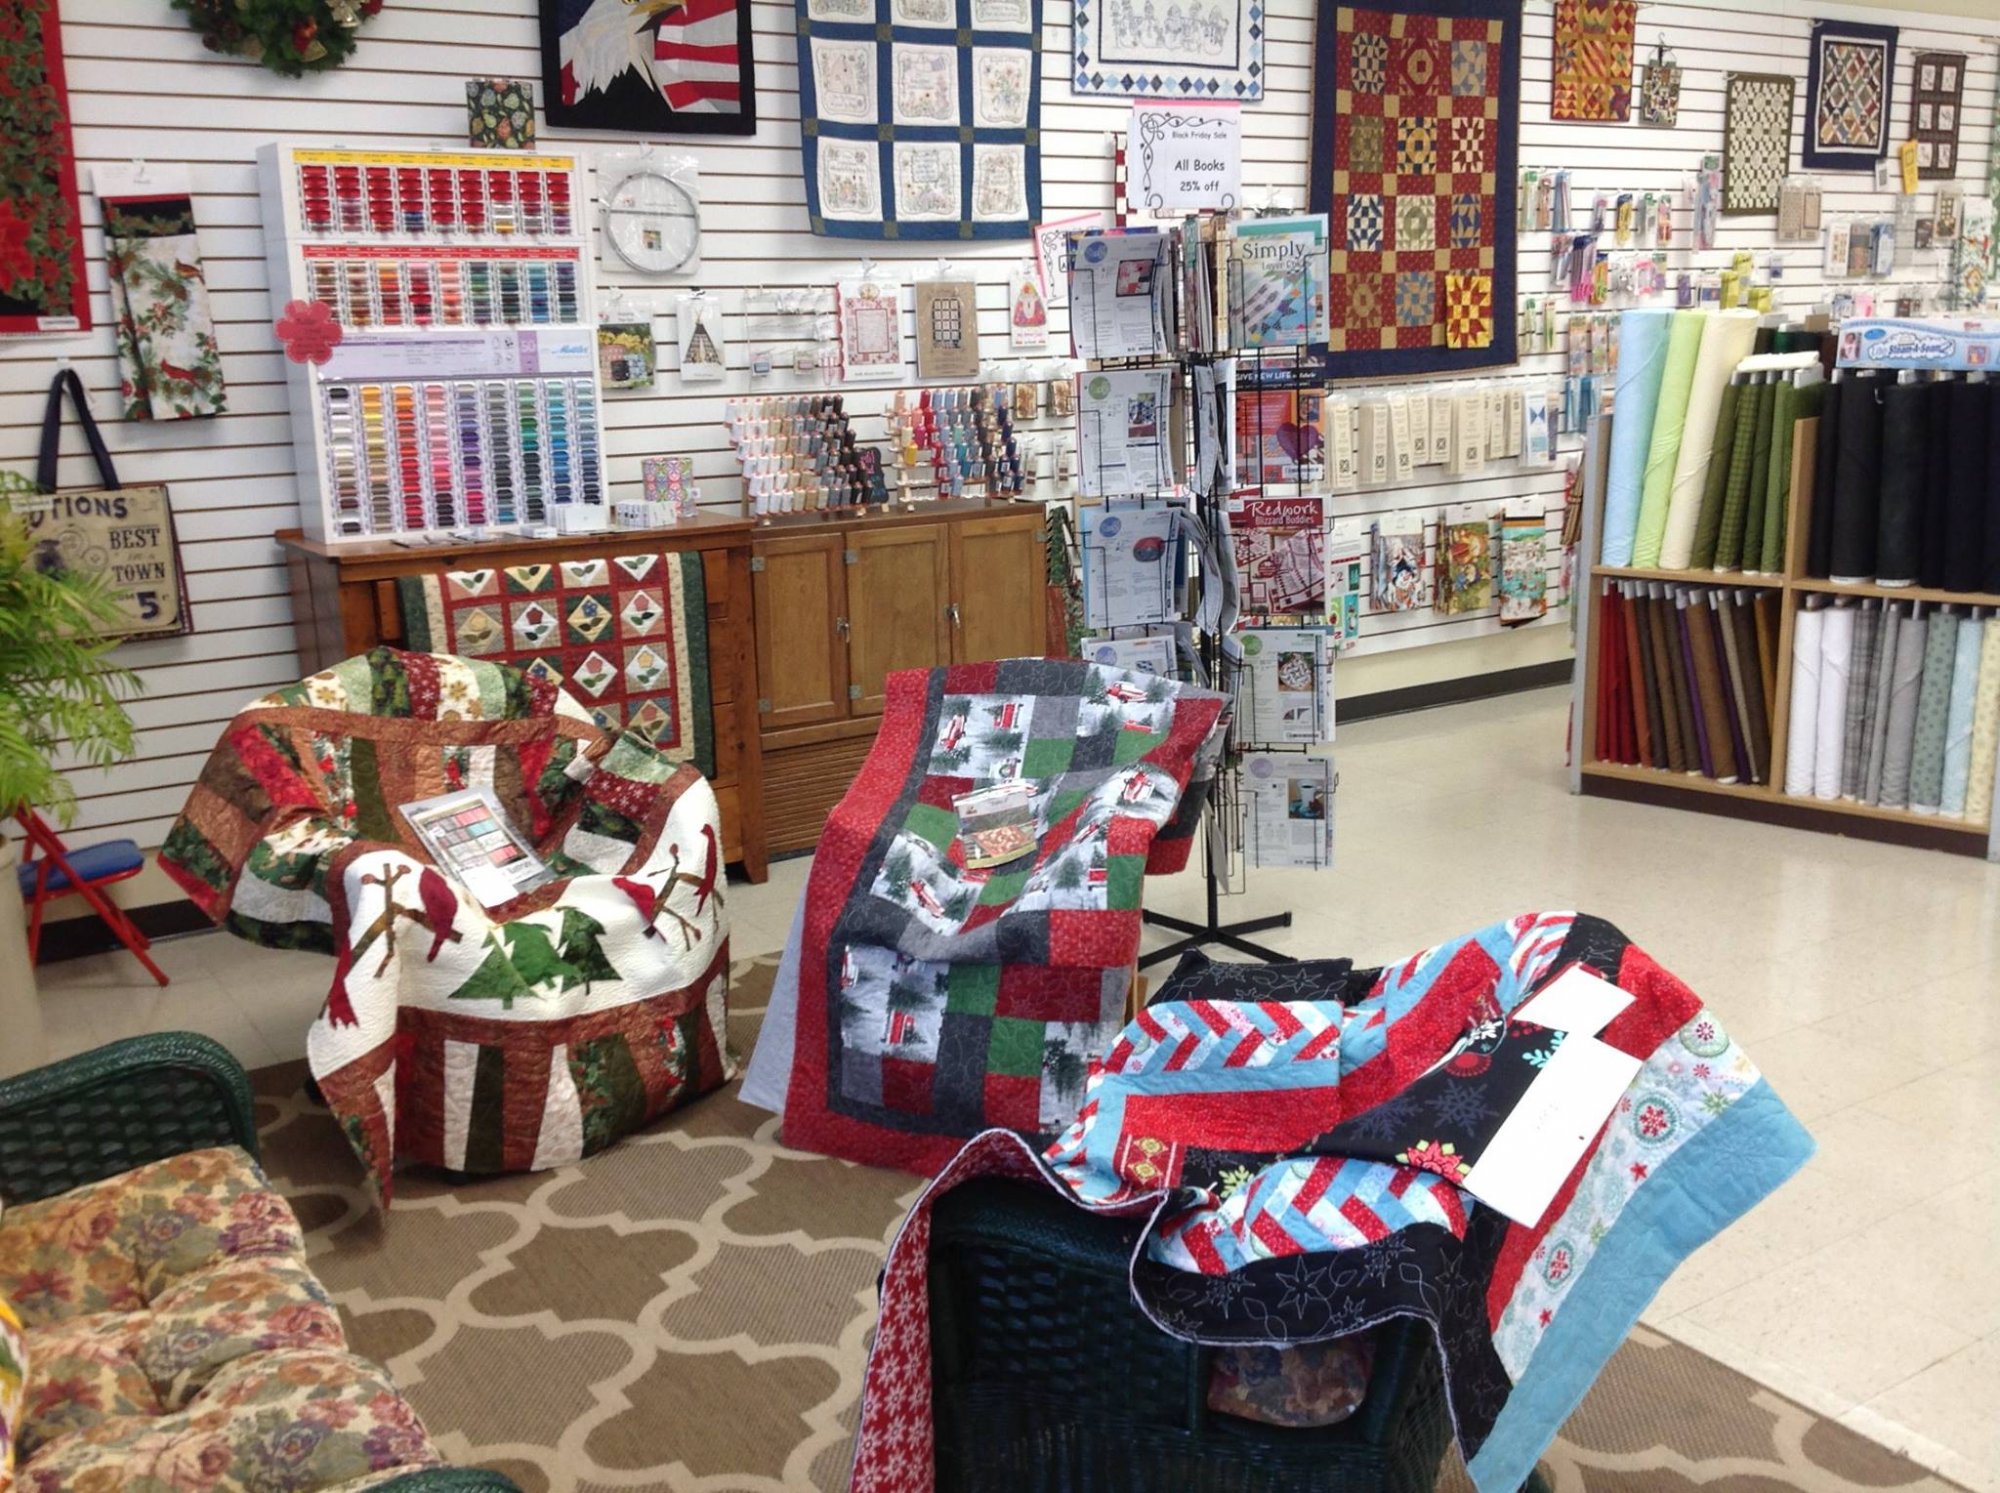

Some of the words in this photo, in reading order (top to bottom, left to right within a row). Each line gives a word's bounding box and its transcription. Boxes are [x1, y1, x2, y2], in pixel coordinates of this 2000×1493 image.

[1172, 131, 1188, 139] Black
[1191, 131, 1211, 141] Friday
[1213, 131, 1227, 139] Sale
[1174, 159, 1189, 171] All
[1193, 159, 1225, 171] Books
[1180, 181, 1200, 192] 25%
[1204, 180, 1220, 192] off
[1242, 240, 1305, 261] Simply
[1274, 371, 1291, 380] LIFE
[1245, 501, 1318, 517] Redwork
[109, 528, 161, 549] BEST
[112, 562, 165, 582] TOWN
[136, 591, 161, 620] 5
